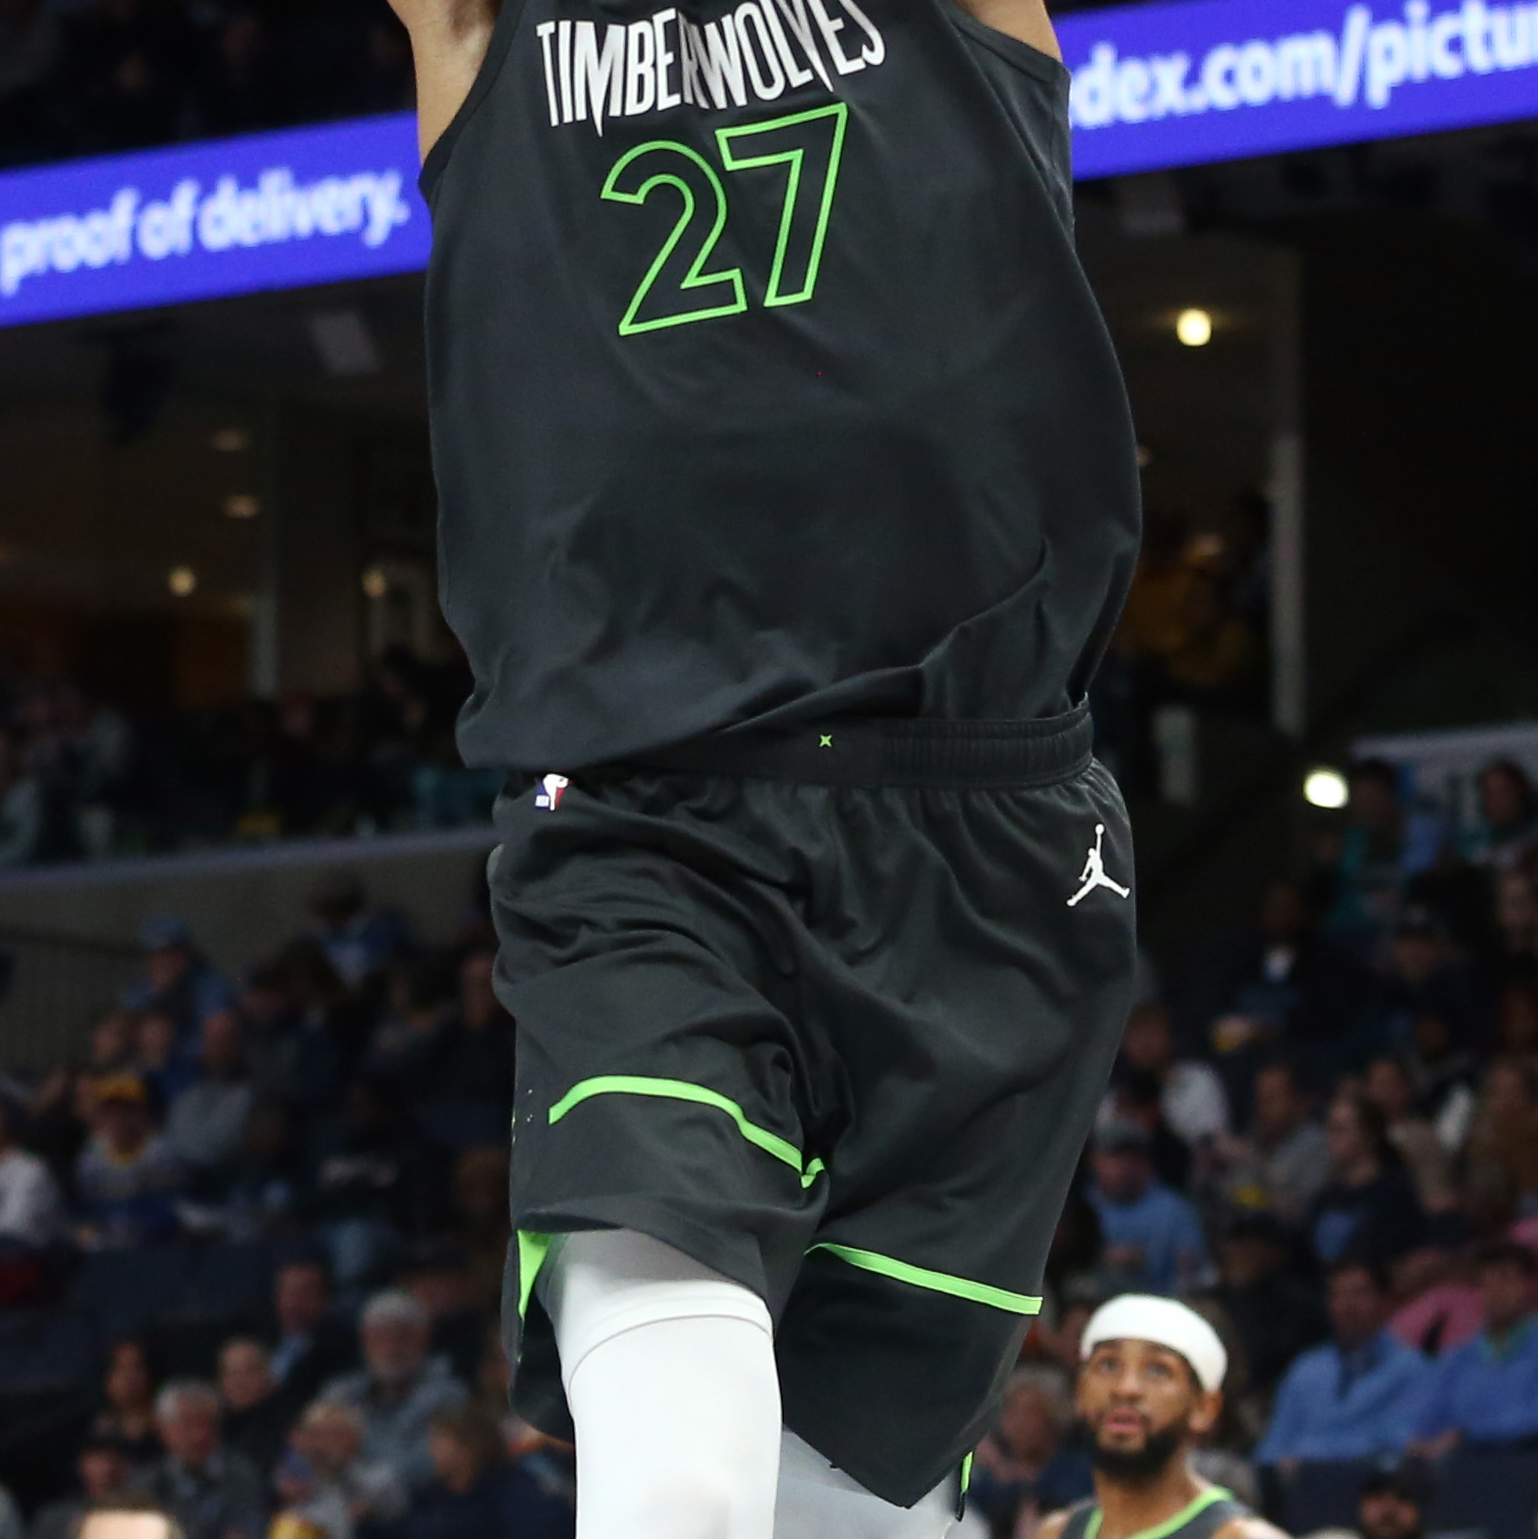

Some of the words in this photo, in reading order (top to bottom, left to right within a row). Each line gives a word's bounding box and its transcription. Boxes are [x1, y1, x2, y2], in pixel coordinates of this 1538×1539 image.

[138, 179, 201, 261] of
[199, 168, 410, 249] delivery.
[600, 102, 849, 336] 27
